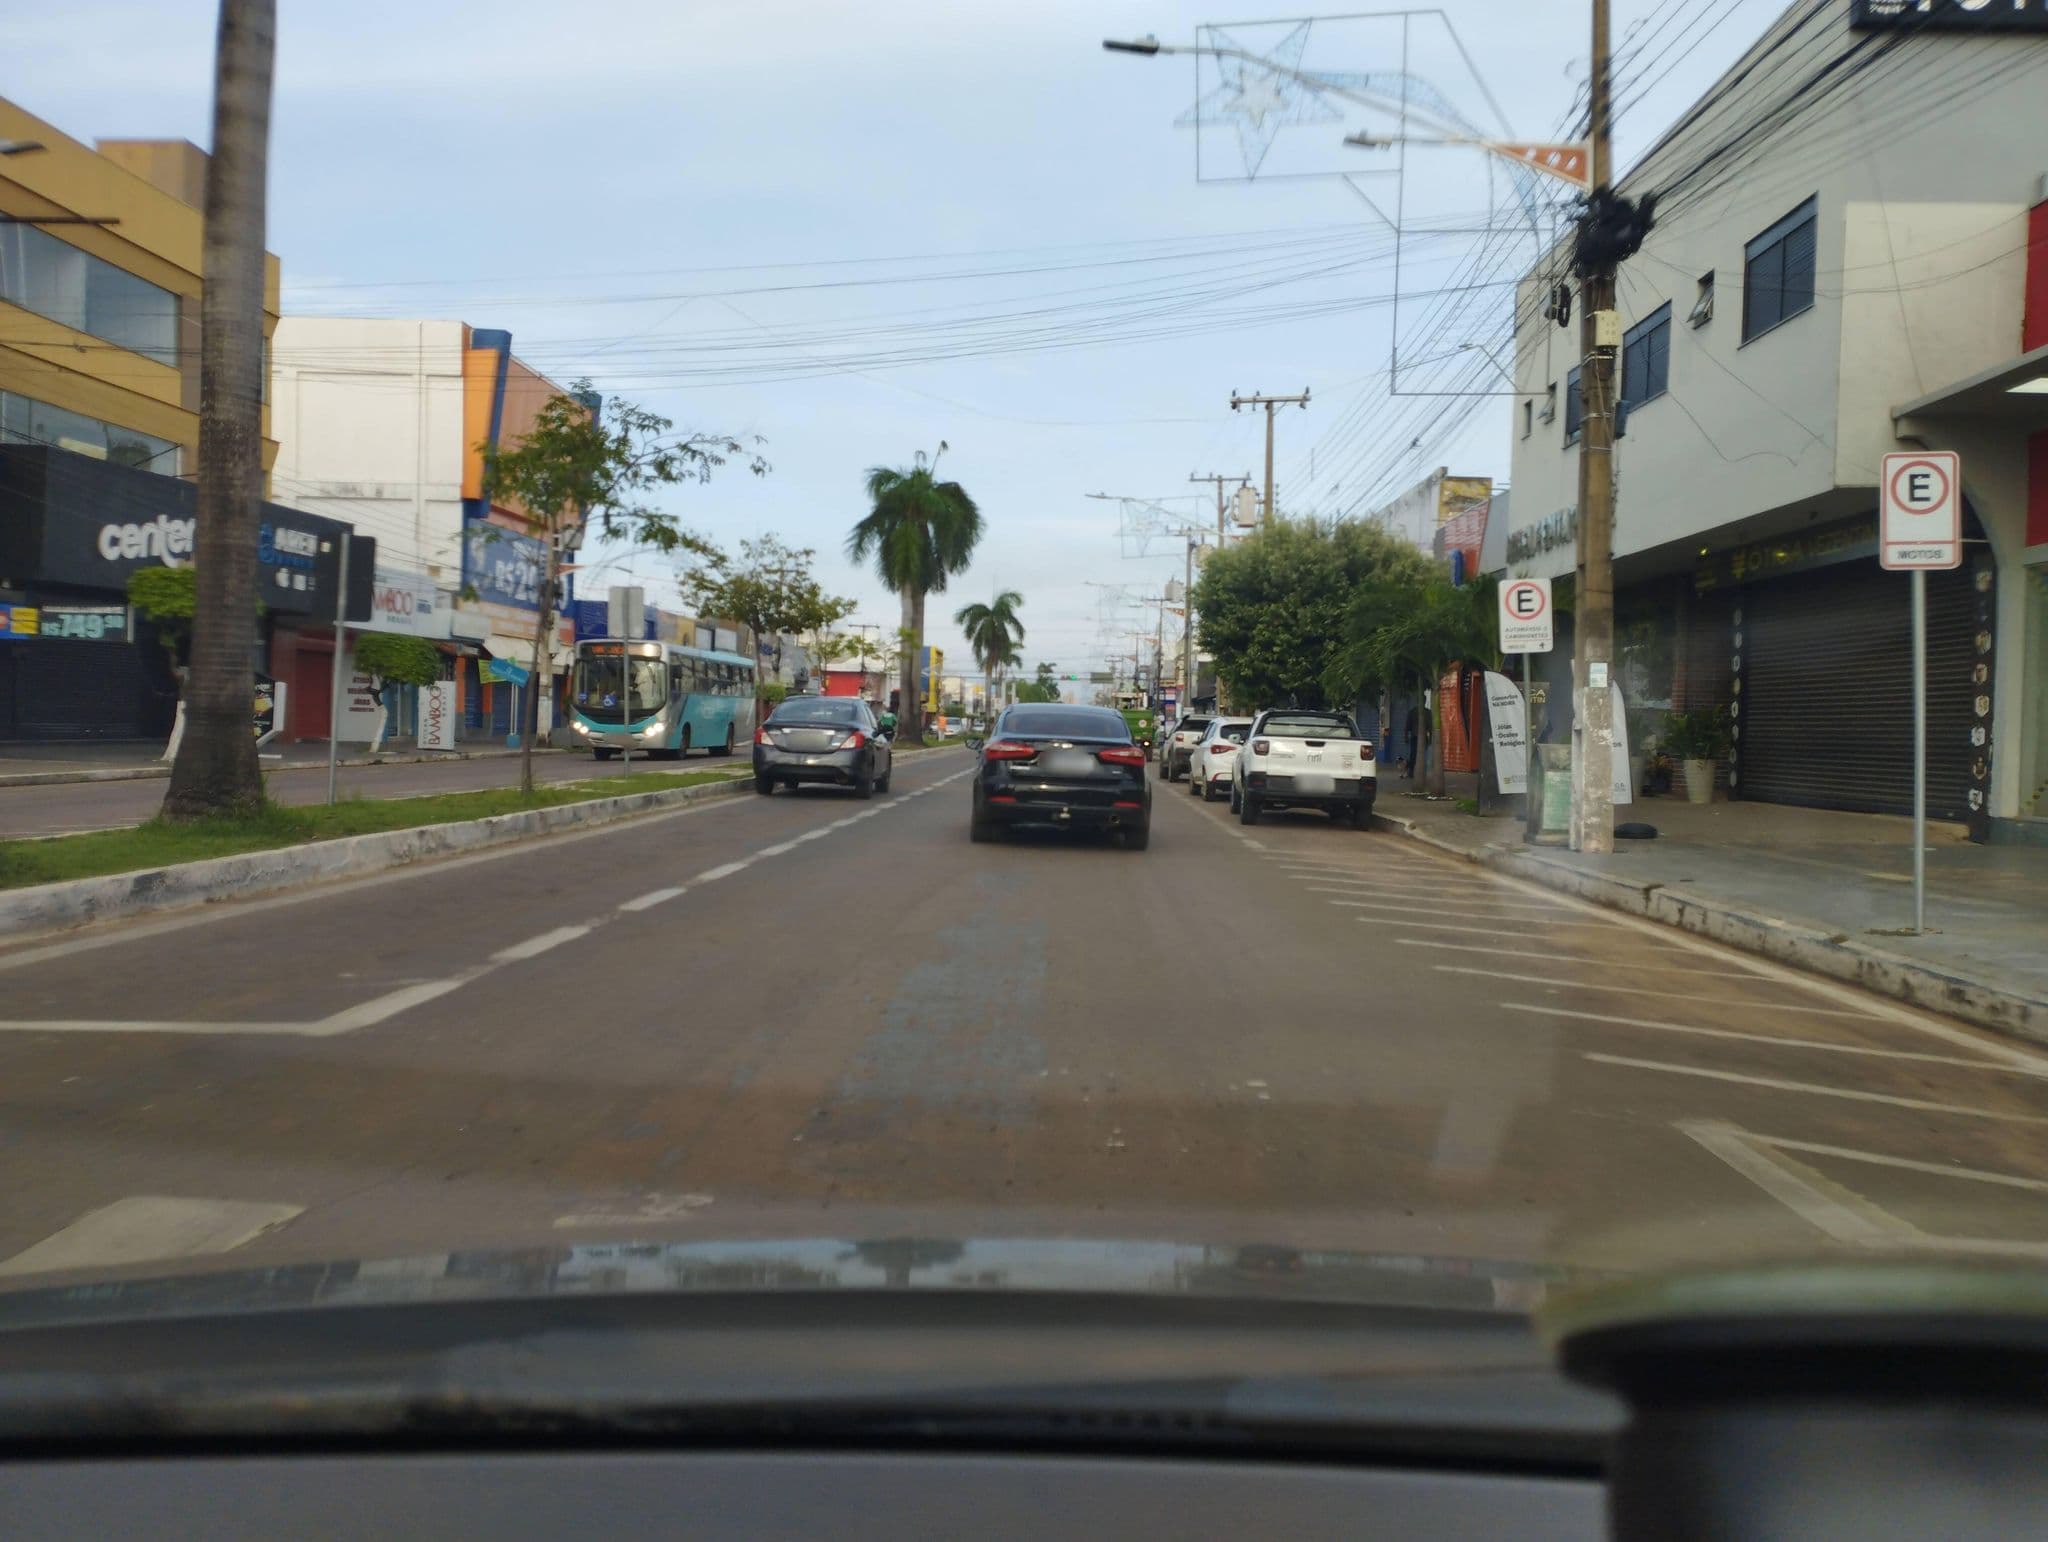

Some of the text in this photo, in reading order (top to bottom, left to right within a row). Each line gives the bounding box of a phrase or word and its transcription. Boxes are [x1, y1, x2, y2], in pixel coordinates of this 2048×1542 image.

[1909, 473, 1931, 502] E
[1897, 549, 1945, 560] MOTOS
[1517, 590, 1535, 613] E
[428, 685, 442, 745] BAMBOO
